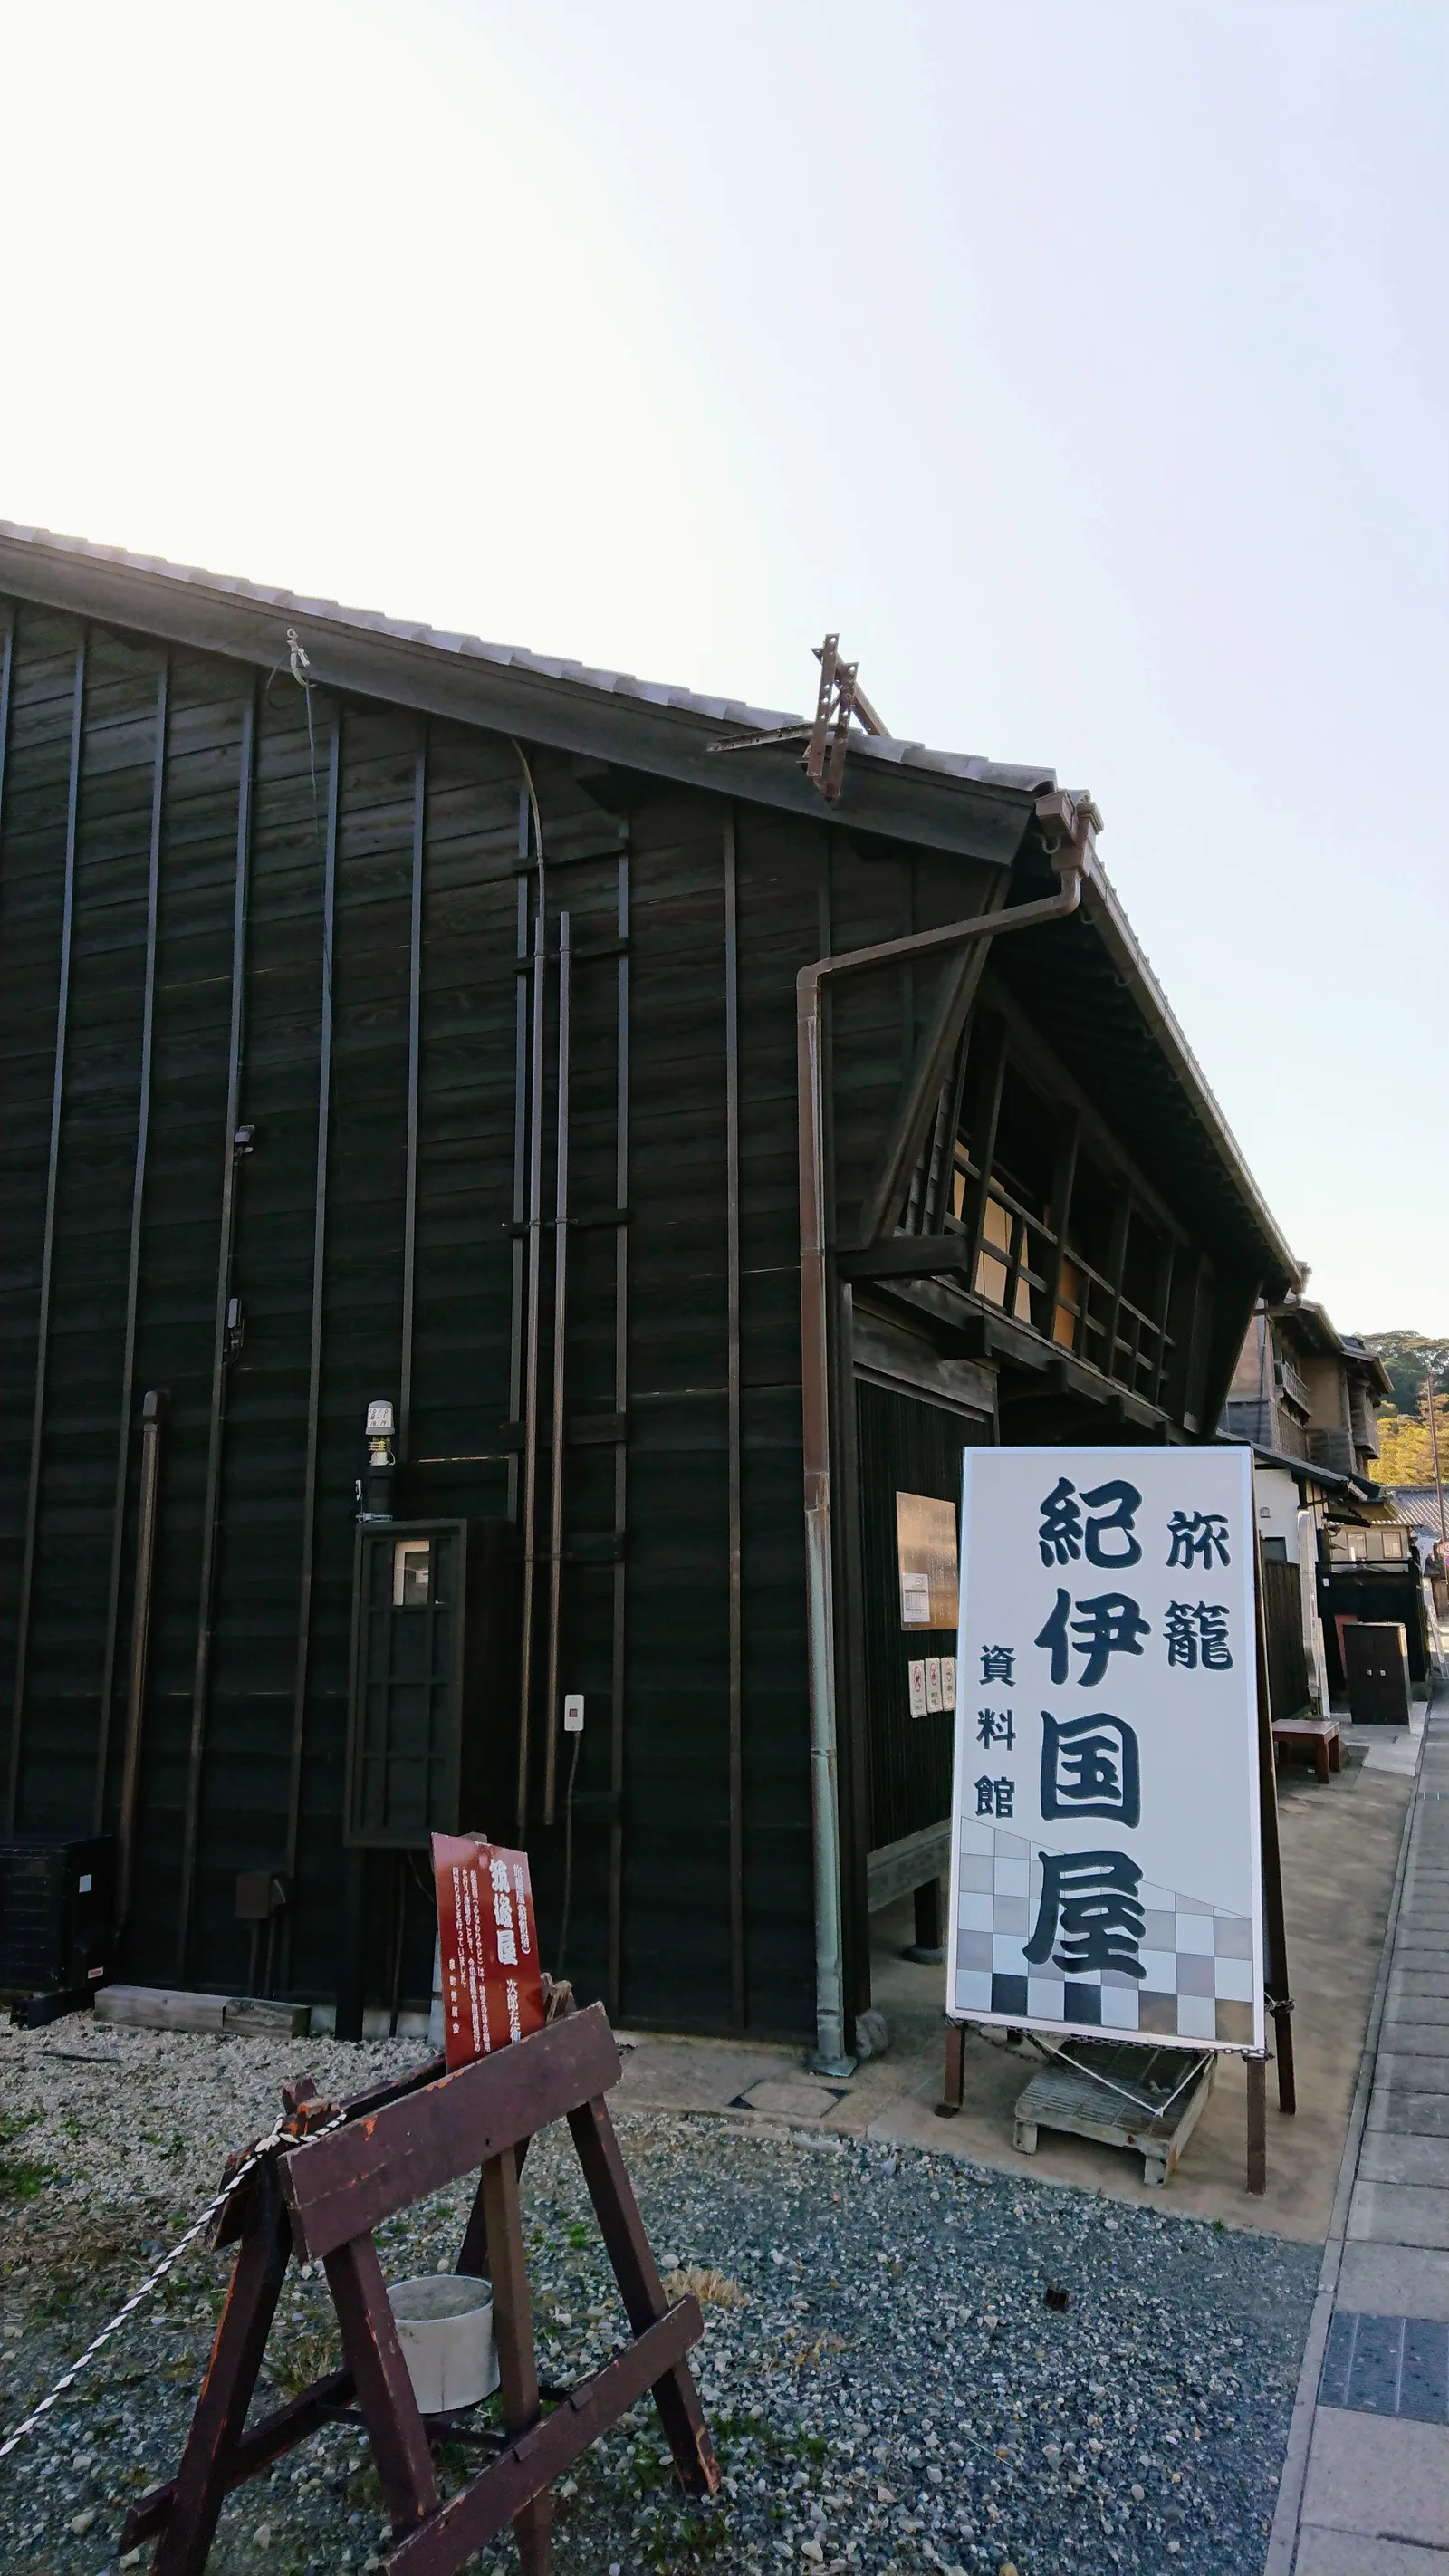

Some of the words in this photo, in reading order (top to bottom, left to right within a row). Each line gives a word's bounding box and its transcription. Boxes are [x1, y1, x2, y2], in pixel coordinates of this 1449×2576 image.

[1163, 1510, 1233, 1671] 旅籠
[974, 1643, 1017, 1819] 資料館
[1022, 1476, 1152, 1981] 紀伊国屋
[489, 1859, 518, 1966] 筑後屋
